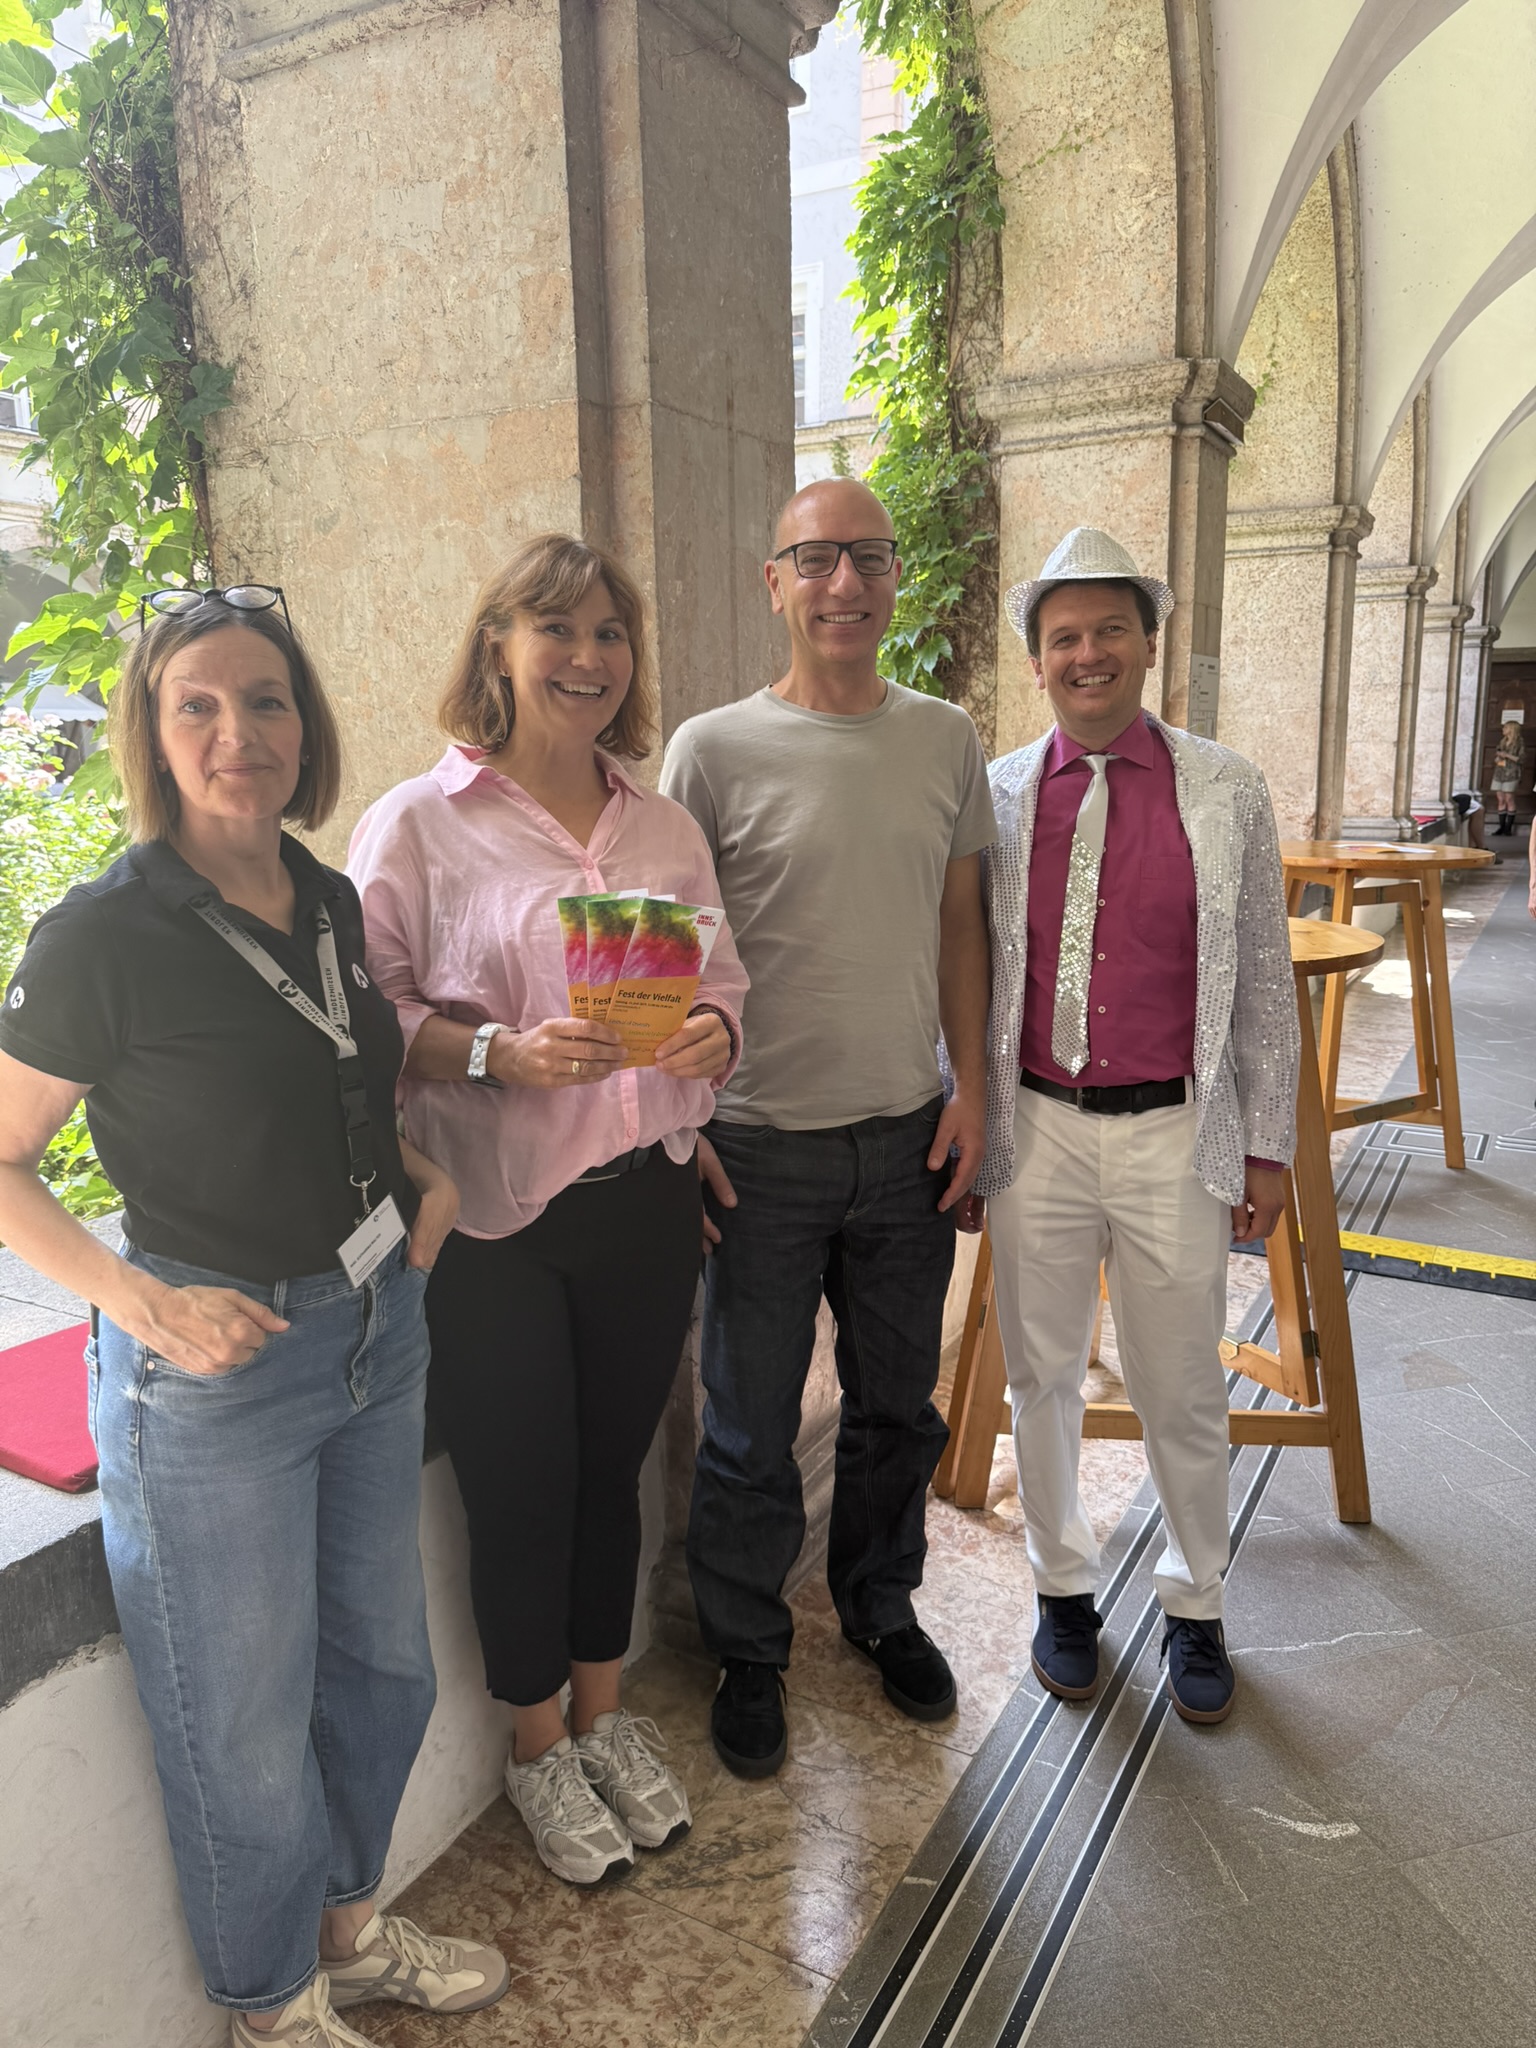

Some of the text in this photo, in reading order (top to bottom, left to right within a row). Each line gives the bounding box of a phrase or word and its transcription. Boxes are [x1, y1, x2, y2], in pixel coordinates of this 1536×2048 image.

[618, 989, 682, 1003] Fest der Vielfalt
